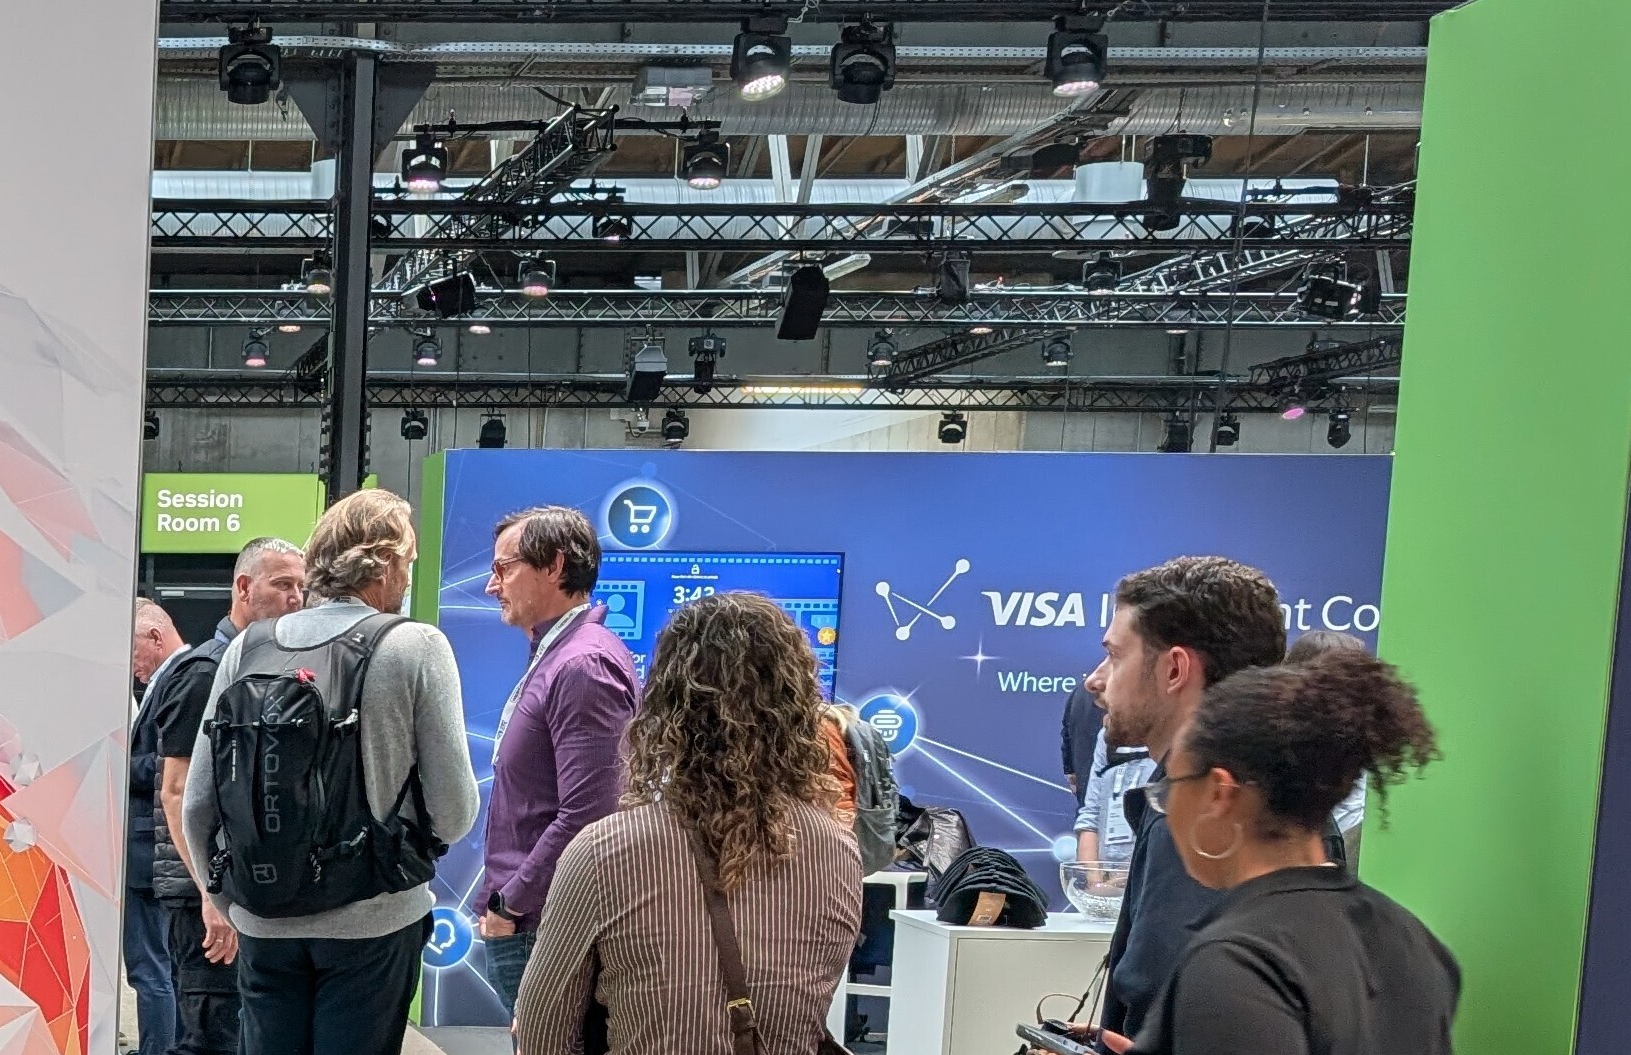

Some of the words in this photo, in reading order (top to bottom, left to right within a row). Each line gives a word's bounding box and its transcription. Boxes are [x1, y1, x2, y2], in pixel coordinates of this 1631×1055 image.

[157, 489, 243, 508] Session
[157, 513, 220, 532] Room
[226, 513, 241, 532] 6
[981, 591, 1085, 627] VISA
[998, 671, 1076, 693] Where
